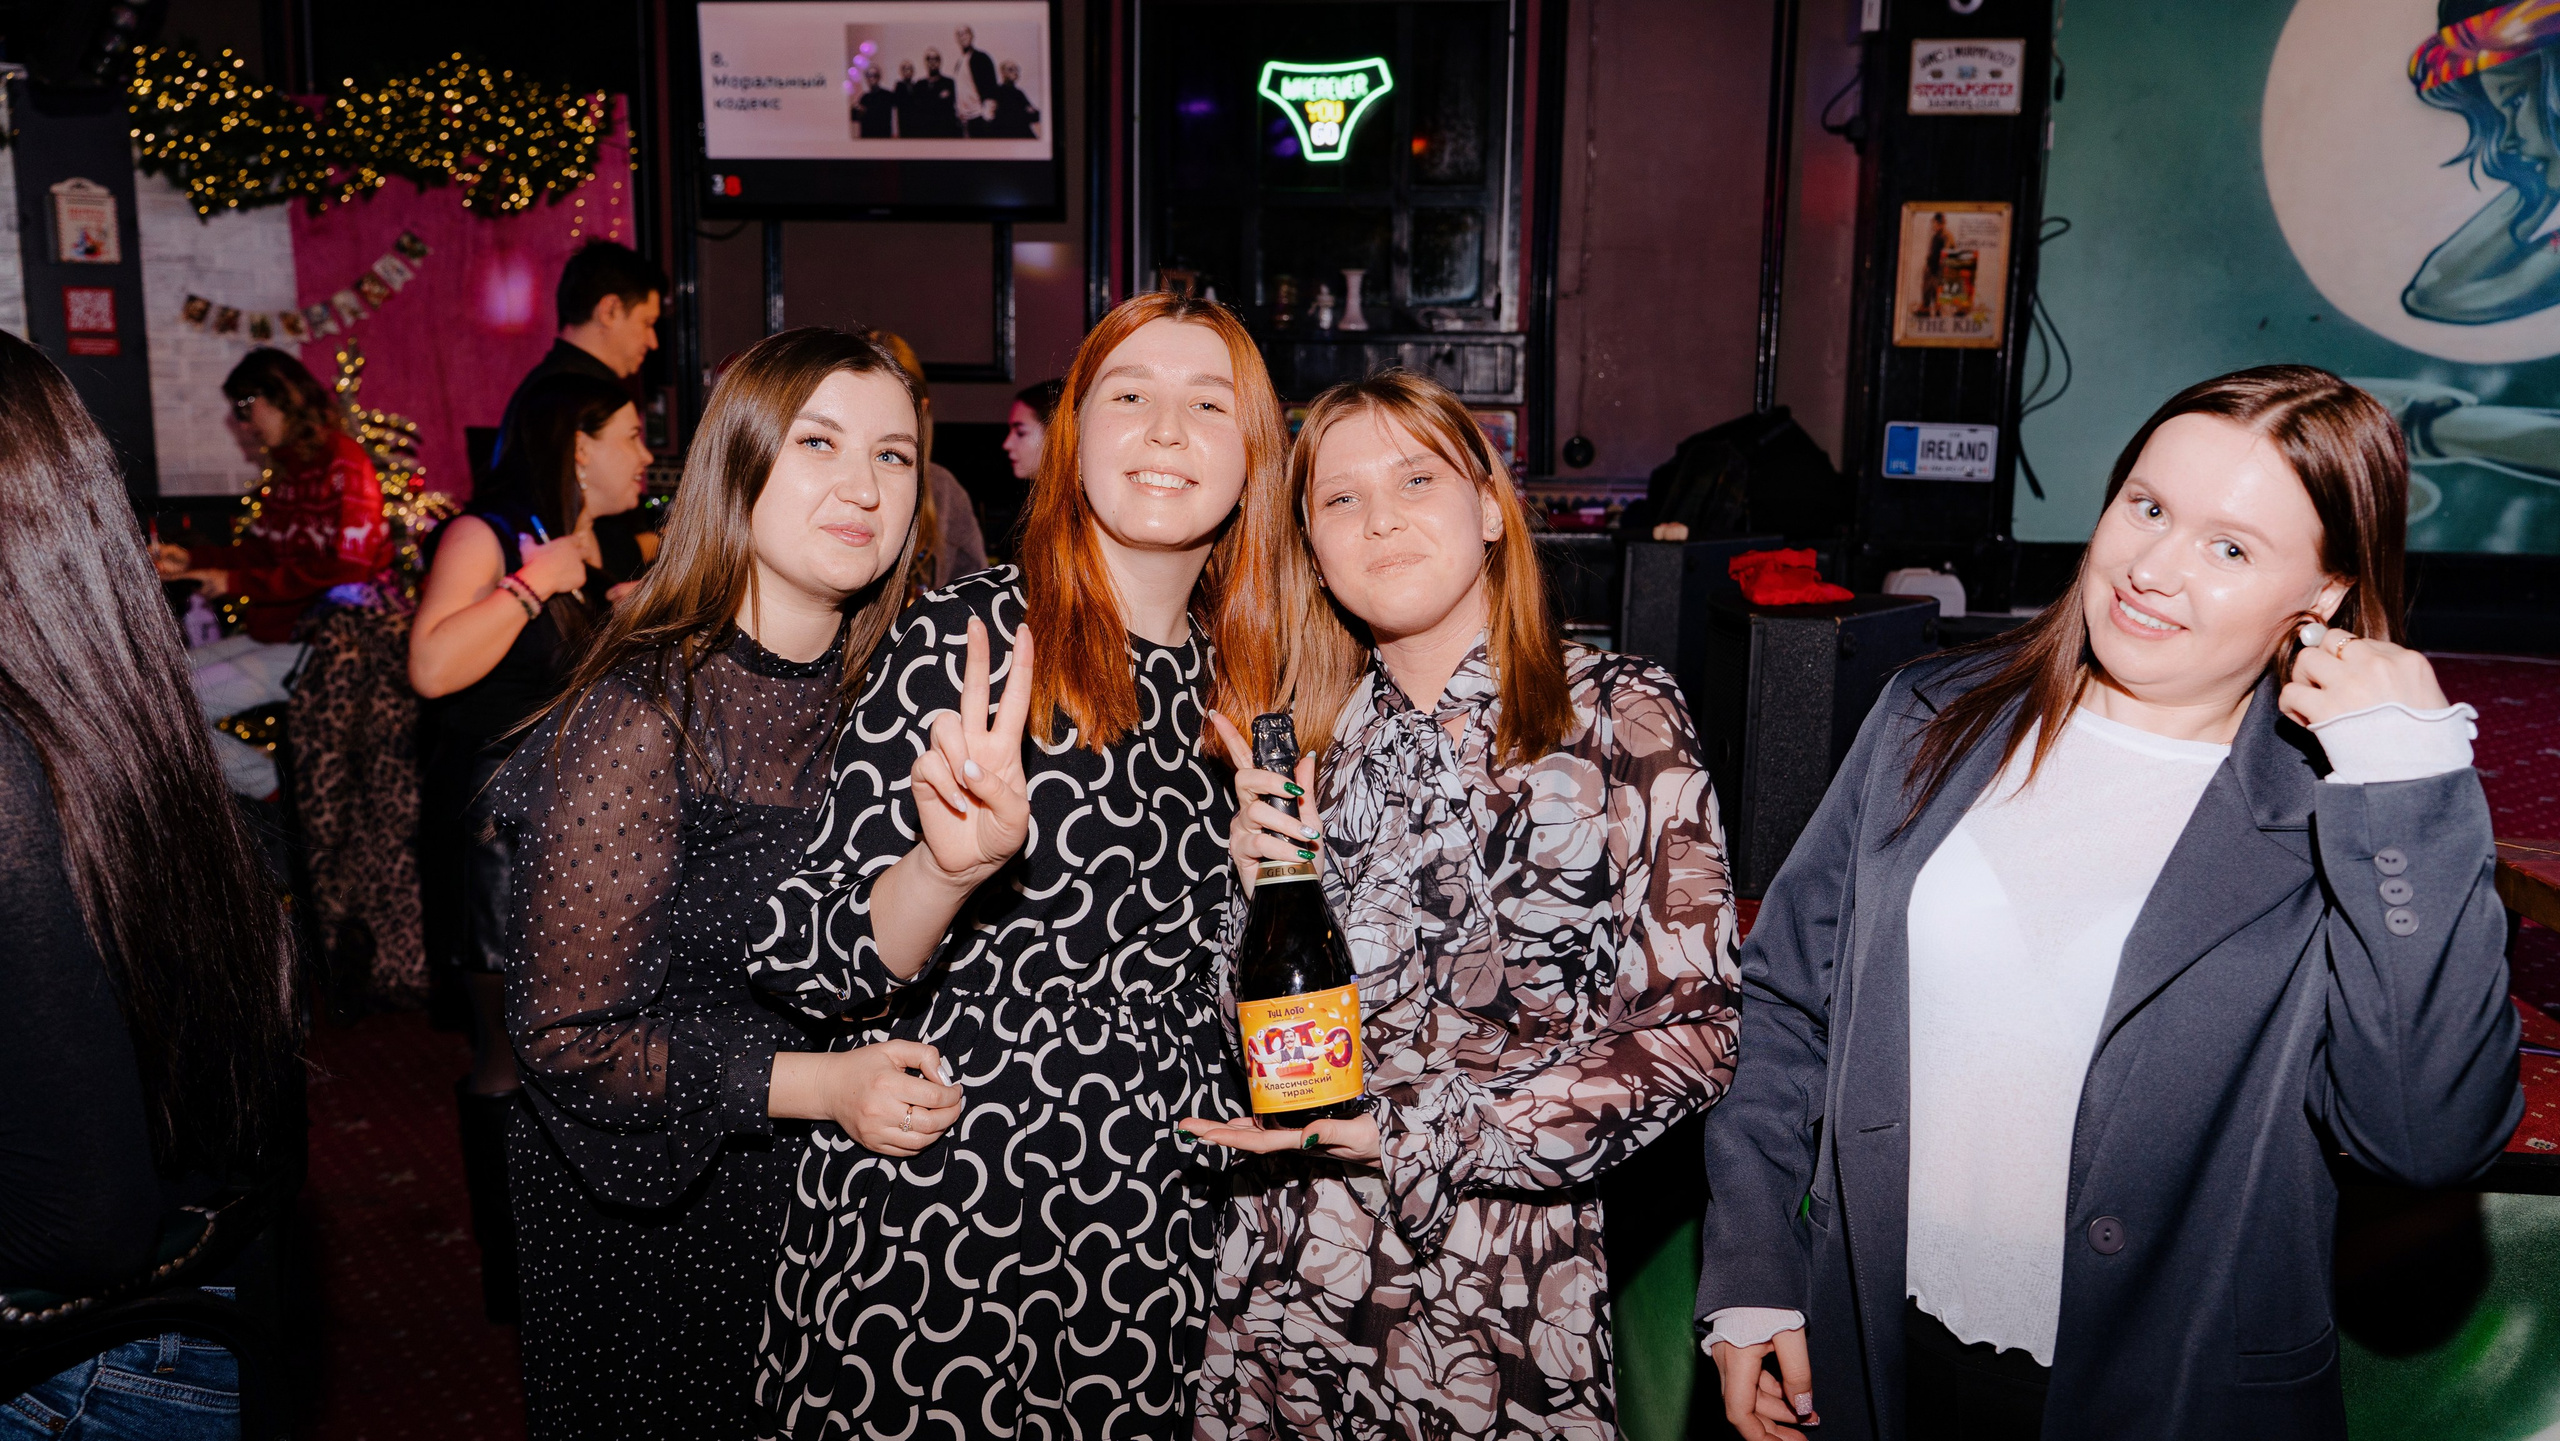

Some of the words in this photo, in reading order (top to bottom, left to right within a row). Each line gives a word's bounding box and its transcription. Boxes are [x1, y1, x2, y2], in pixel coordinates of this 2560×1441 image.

[712, 72, 827, 92] Моральный
[1280, 72, 1369, 101] WHEREVER
[713, 97, 782, 111] кодекс
[1304, 99, 1345, 123] YOU
[1310, 121, 1340, 146] GO
[1916, 318, 1945, 333] THE
[1921, 439, 1989, 462] IRELAND
[1266, 866, 1297, 877] GELO
[1264, 1074, 1332, 1091] Классический
[1282, 1087, 1314, 1099] тираж
